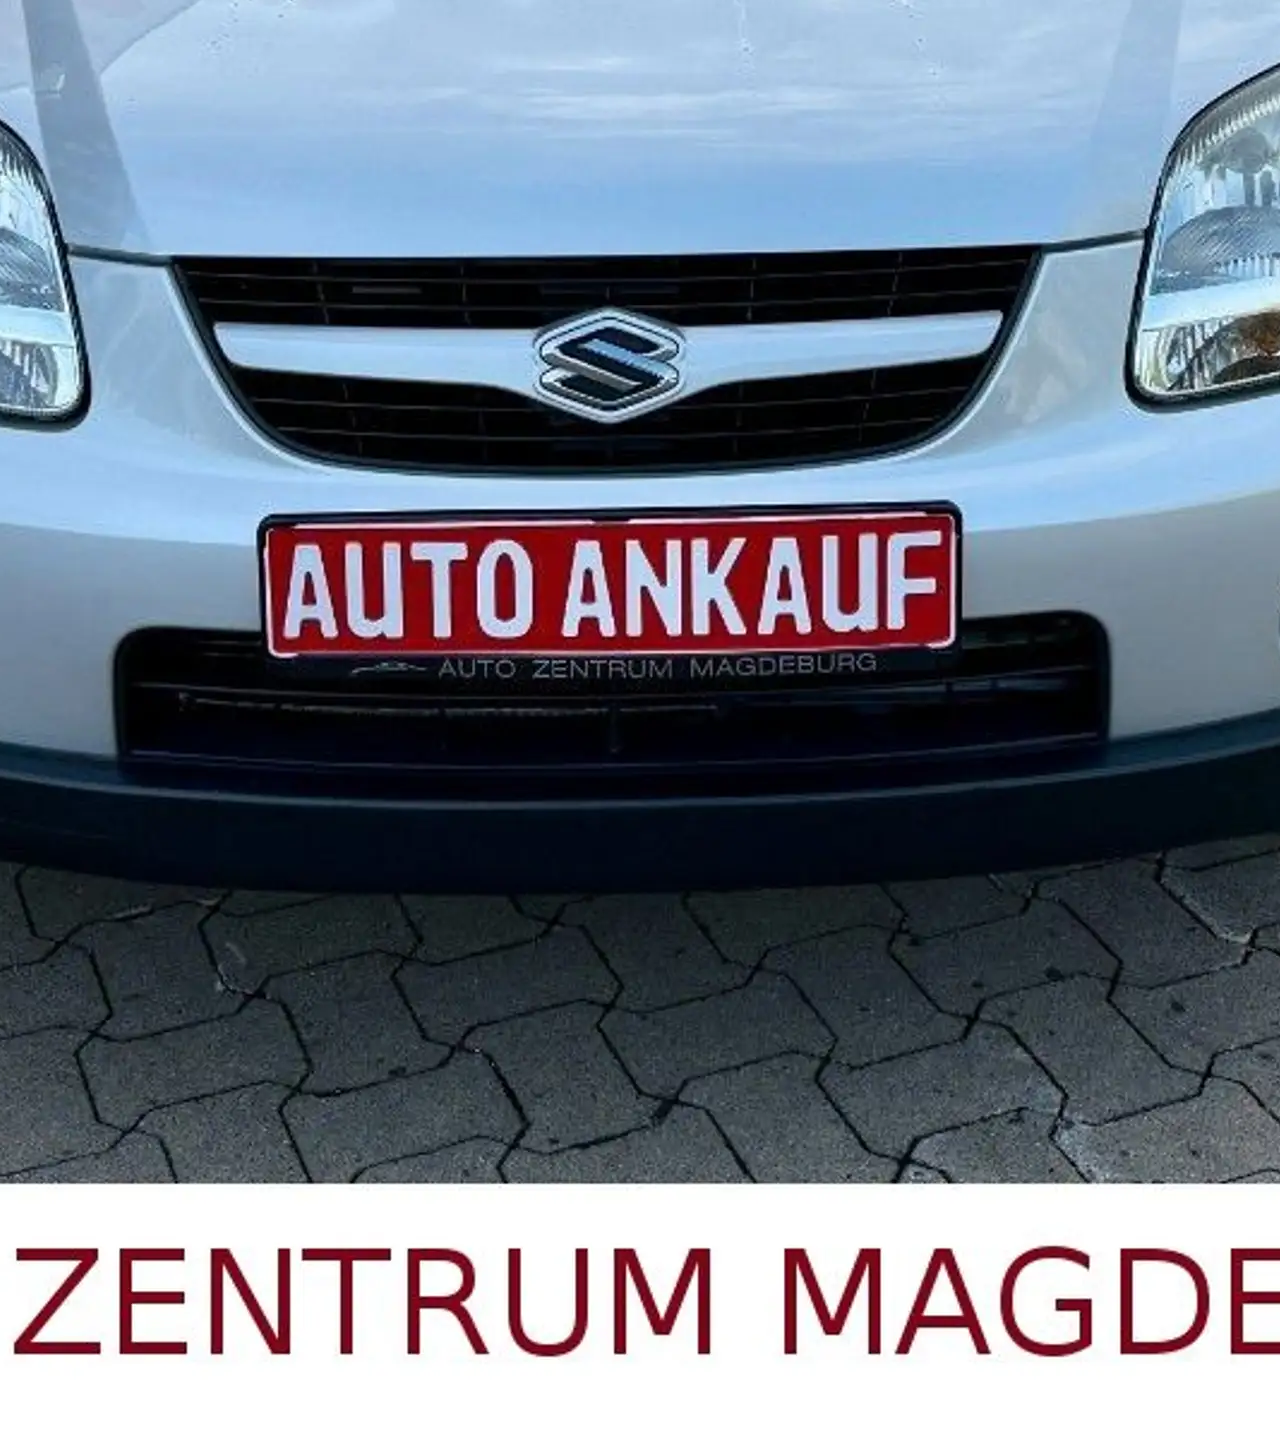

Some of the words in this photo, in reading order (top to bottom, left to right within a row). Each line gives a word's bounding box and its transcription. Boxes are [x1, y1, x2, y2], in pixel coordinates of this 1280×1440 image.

[282, 538, 535, 640] AUTO
[561, 529, 943, 639] ANKAUF
[437, 658, 516, 679] AUTO
[532, 657, 673, 679] ZENTRUM
[689, 652, 878, 678] MAGDEBURG
